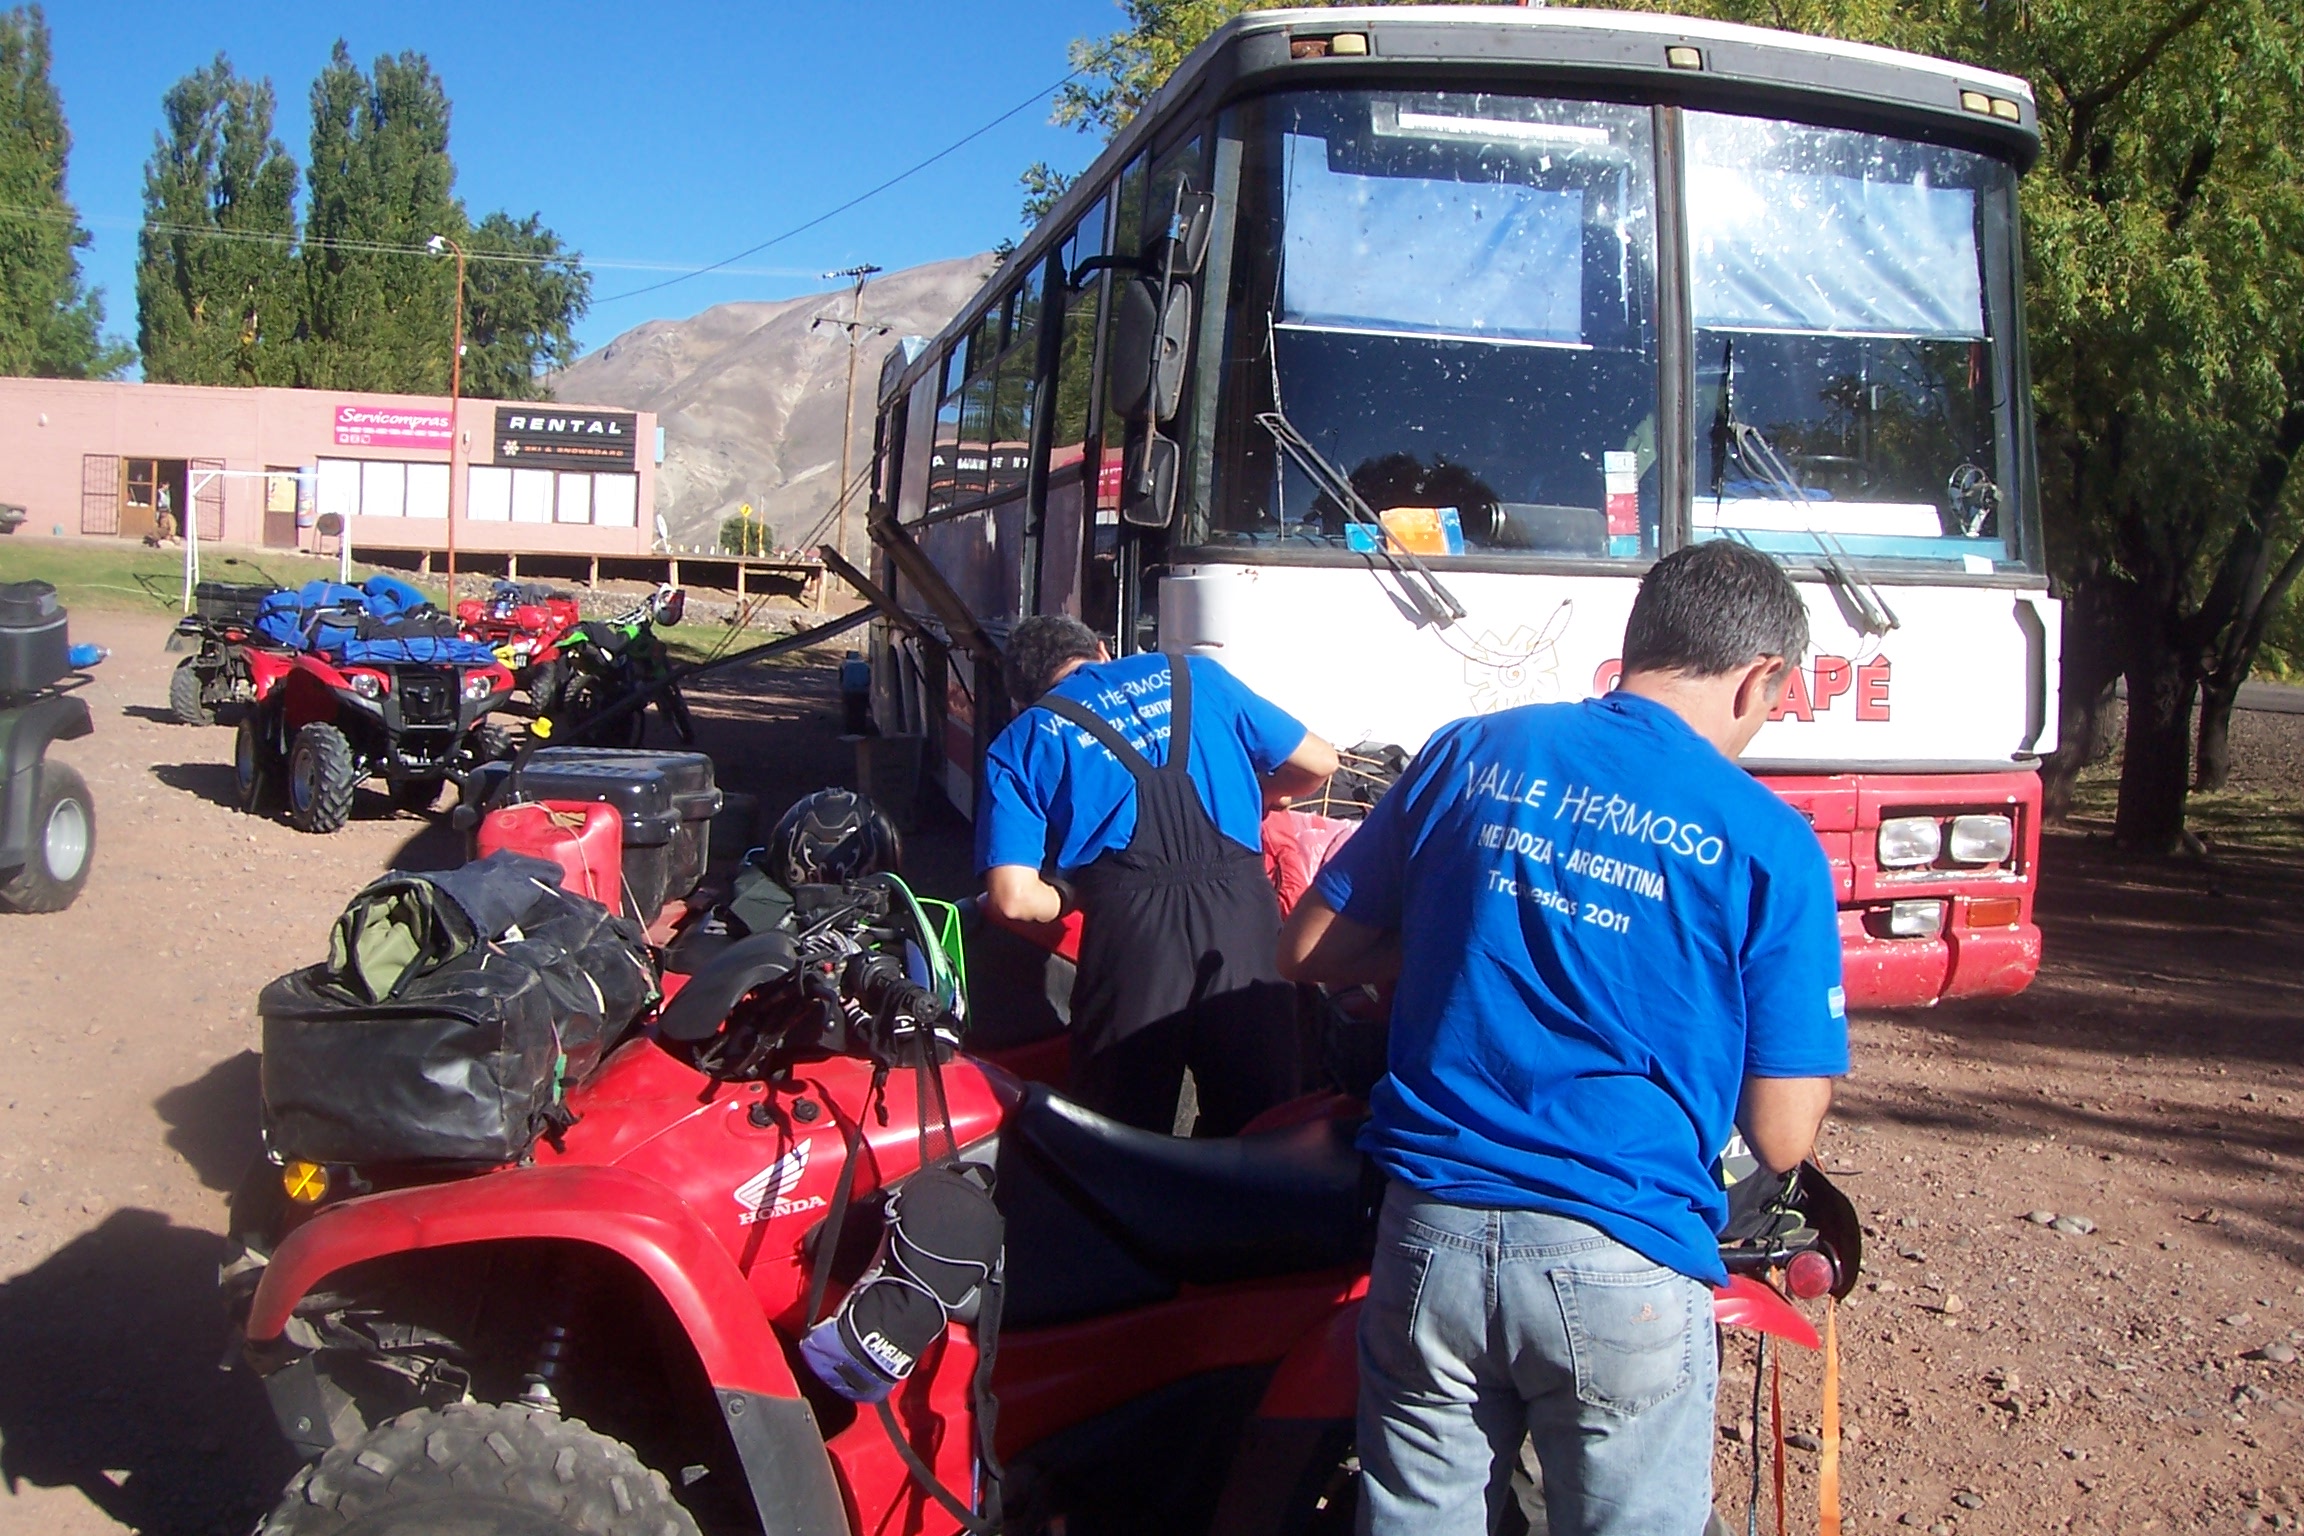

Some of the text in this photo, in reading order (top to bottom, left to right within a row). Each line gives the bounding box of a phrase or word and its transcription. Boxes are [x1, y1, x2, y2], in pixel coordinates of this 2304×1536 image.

[339, 408, 449, 430] Servicompras
[509, 416, 622, 434] RENTAL
[1097, 669, 1171, 710] HERMOS
[1465, 761, 1724, 865] VALLE HERMOSO
[1478, 823, 1553, 865] MENDOZA
[1565, 849, 1666, 901] ARGENTINA
[1583, 903, 1631, 934] 2011
[738, 1195, 827, 1226] HONDA
